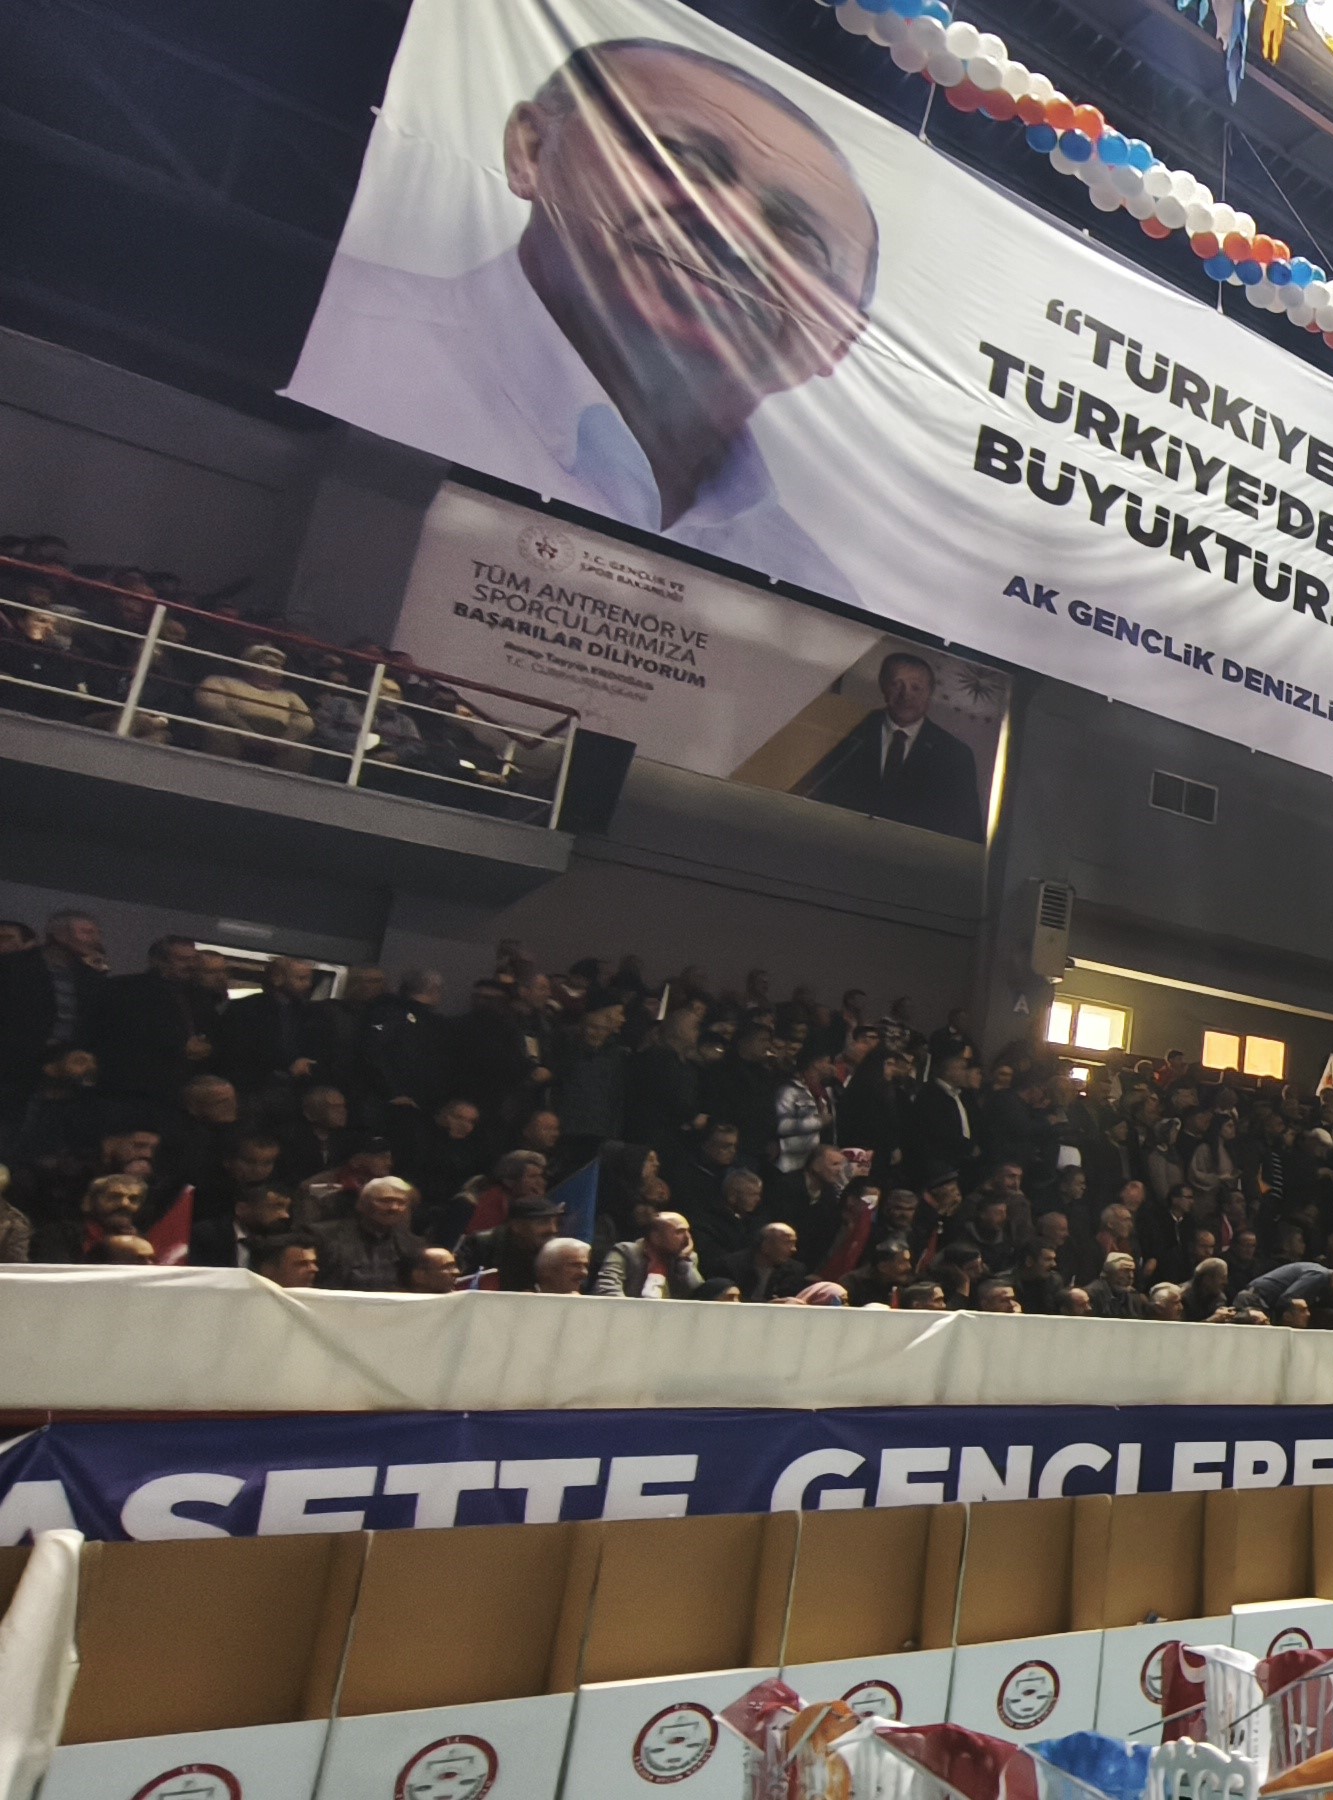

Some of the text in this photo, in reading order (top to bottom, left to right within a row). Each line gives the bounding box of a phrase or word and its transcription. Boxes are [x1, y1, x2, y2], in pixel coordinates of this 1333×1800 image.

[453, 601, 706, 688] BAŞARILAR DİLİYORUM
[472, 583, 696, 666] SPORCULARIMIZA
[679, 626, 709, 649] VE
[1003, 576, 1059, 614] AK
[1067, 600, 1214, 676] GENÇLİK
